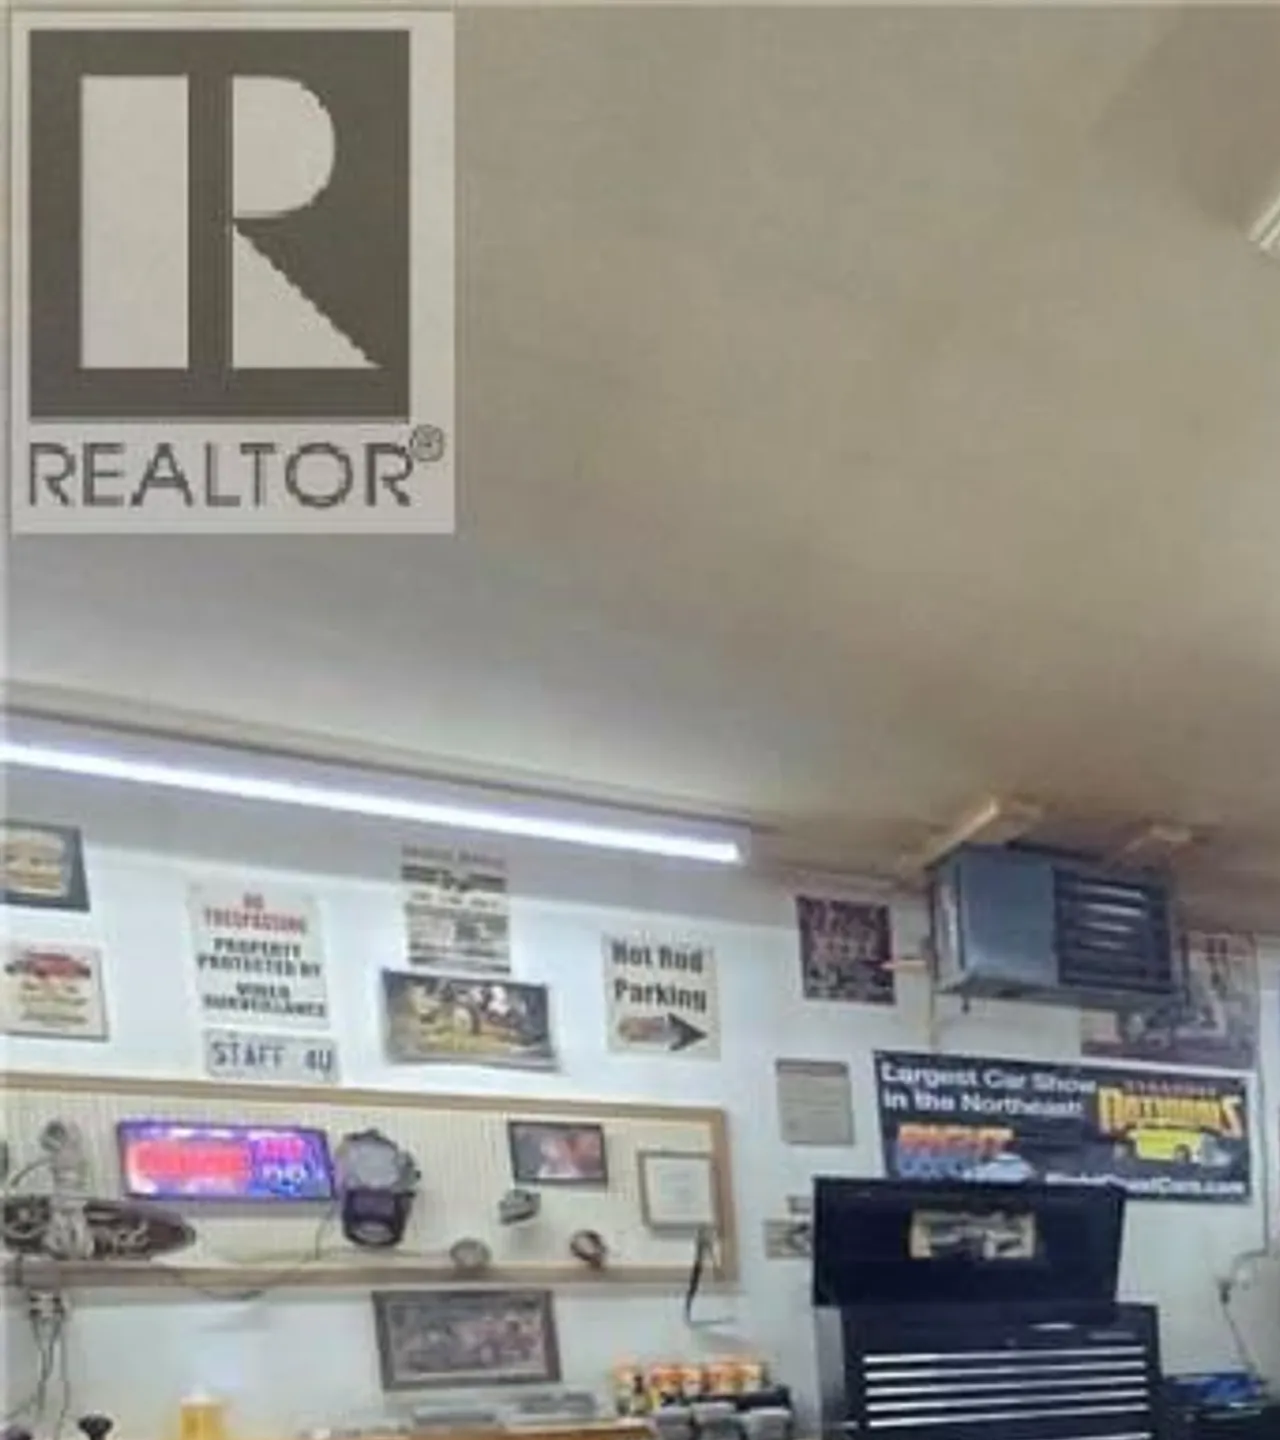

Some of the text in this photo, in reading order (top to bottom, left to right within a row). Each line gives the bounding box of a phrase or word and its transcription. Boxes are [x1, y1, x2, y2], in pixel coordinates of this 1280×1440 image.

[213, 936, 301, 958] PROPERTY
[611, 938, 704, 974] Hot Rod
[197, 953, 297, 977] PROTECTED
[613, 978, 707, 1014] Parking
[211, 1041, 285, 1068] STAFF
[881, 1062, 978, 1089] Largest
[982, 1068, 1027, 1090] Car
[1030, 1072, 1097, 1095] Show
[914, 1089, 955, 1113] the
